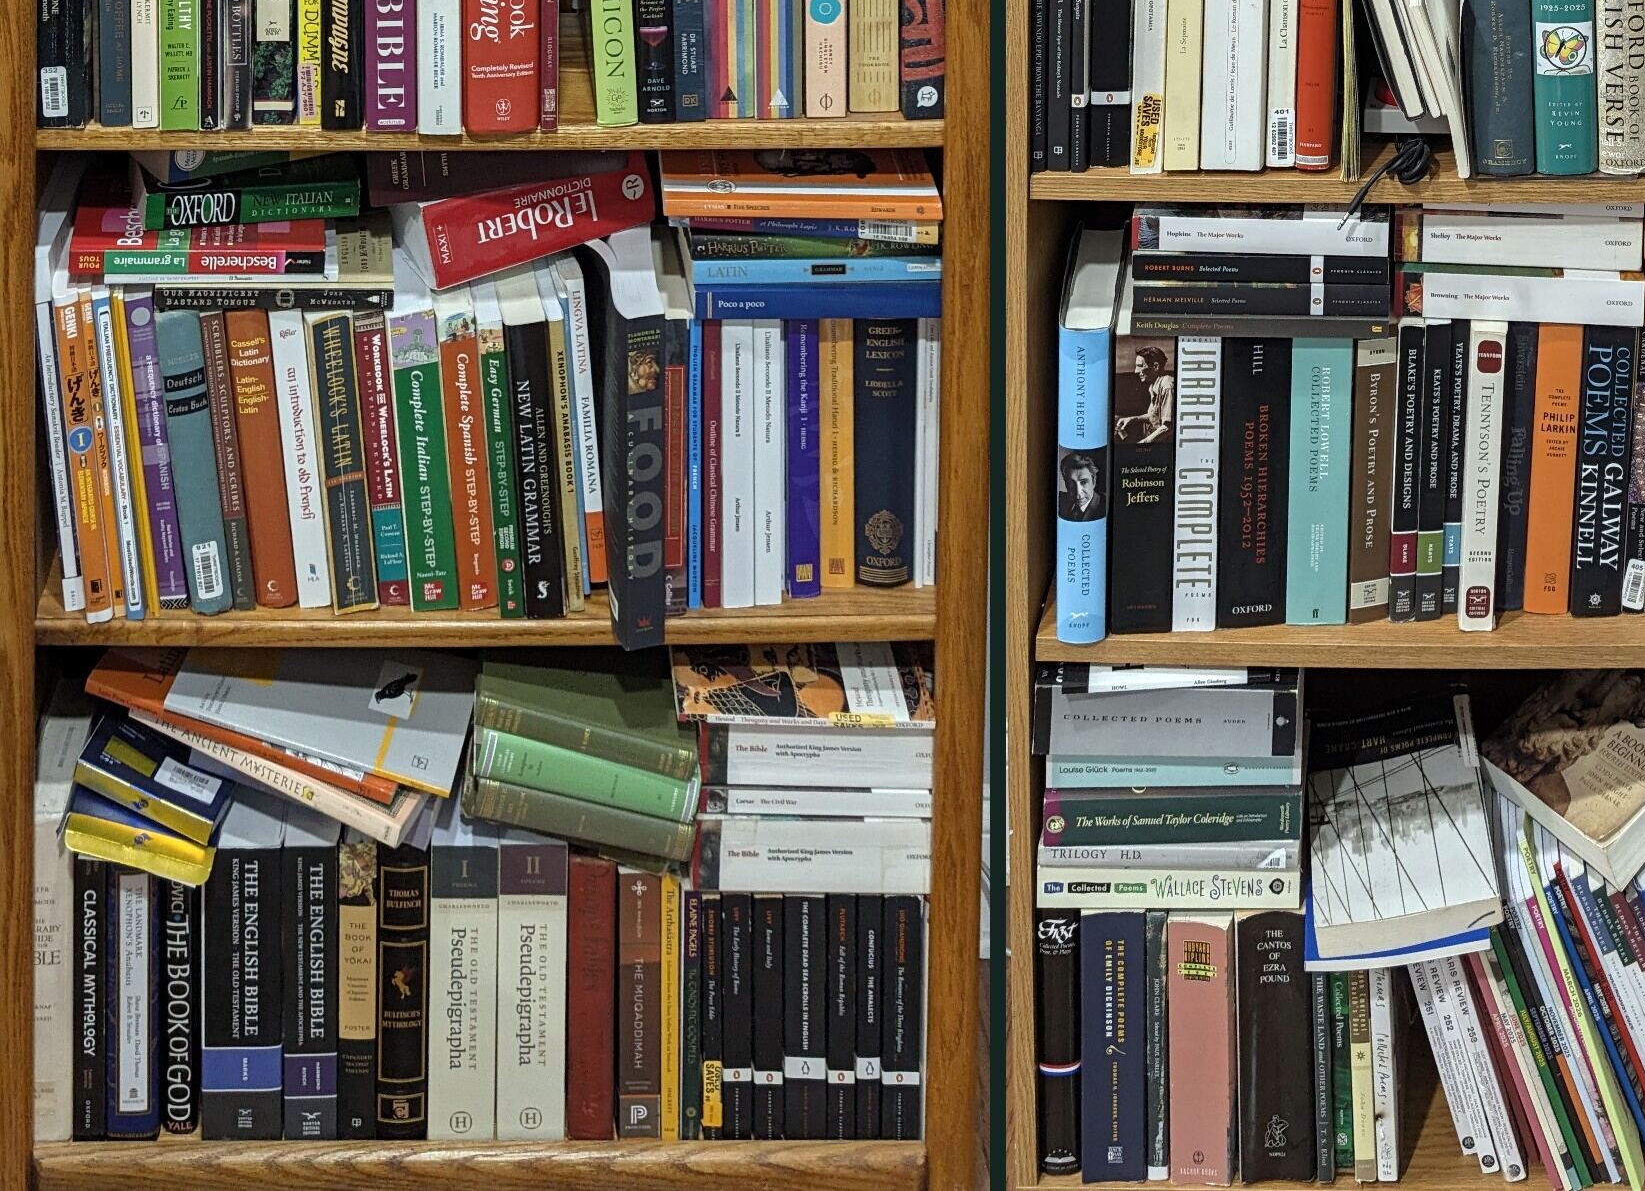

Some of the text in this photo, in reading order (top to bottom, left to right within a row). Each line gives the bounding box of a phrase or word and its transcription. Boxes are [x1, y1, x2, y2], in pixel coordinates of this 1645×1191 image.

[171, 193, 235, 225] OXFORD
[231, 337, 266, 350] Cassell's
[1544, 412, 1576, 422] PHILIP
[1541, 424, 1577, 434] LARKIN
[1122, 478, 1164, 488] Robinson
[1126, 492, 1160, 506] Jeffers
[1232, 604, 1272, 614] OXFORD
[736, 744, 748, 752] The
[1051, 848, 1108, 859] TRILOGY
[1151, 875, 1262, 898] WALLACE STEVENS
[446, 927, 467, 1070] Pseudepigrapha
